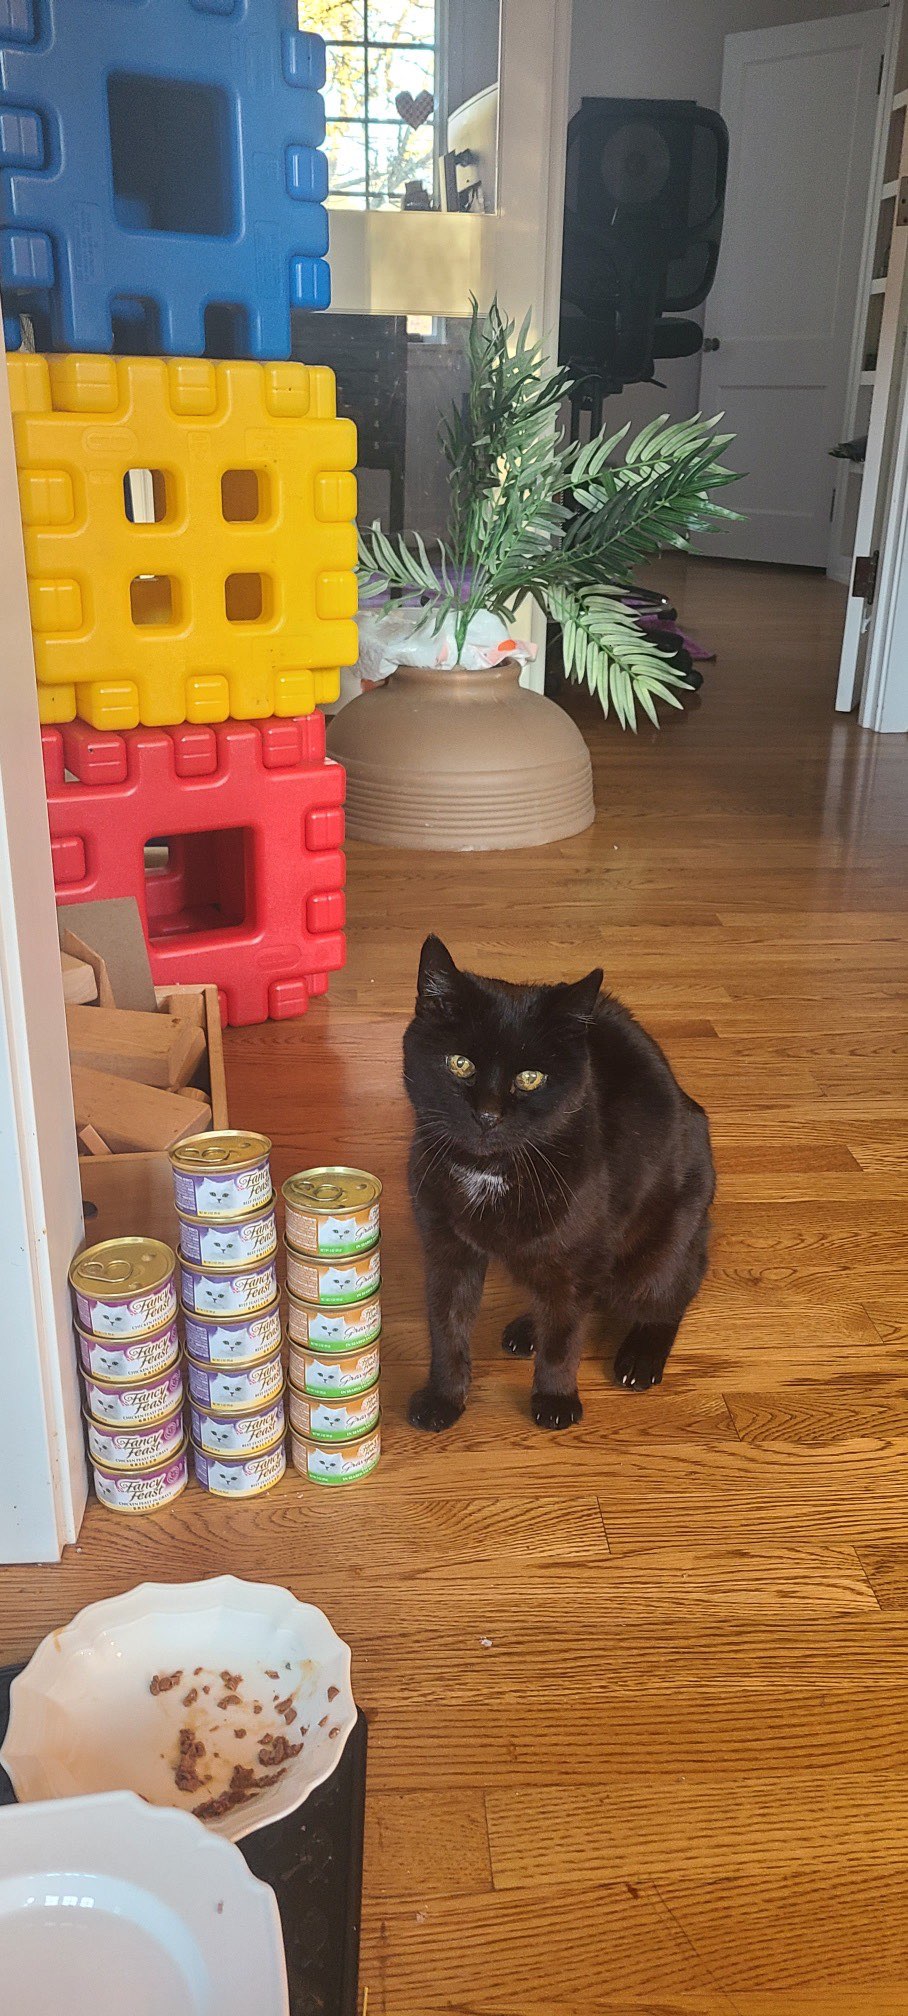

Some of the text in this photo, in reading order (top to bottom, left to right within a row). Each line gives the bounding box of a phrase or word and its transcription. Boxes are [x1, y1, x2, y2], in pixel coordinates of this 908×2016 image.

[235, 1269, 271, 1291] Fancy
[133, 1288, 169, 1311] Fancy
[244, 1282, 271, 1302] Feast
[143, 1299, 170, 1322] Feast
[129, 1336, 168, 1357] Fancy
[140, 1346, 170, 1368] Feast
[124, 1384, 166, 1405] Fancy
[134, 1393, 167, 1414] Feast
[238, 1413, 275, 1433] Fancy
[247, 1422, 276, 1442] Feast
[117, 1432, 161, 1449] Fancy
[127, 1441, 161, 1458] Feast
[248, 1451, 281, 1472] Fancy
[256, 1460, 281, 1482] Feast
[120, 1475, 164, 1493] Fancy
[129, 1485, 164, 1503] Feast
